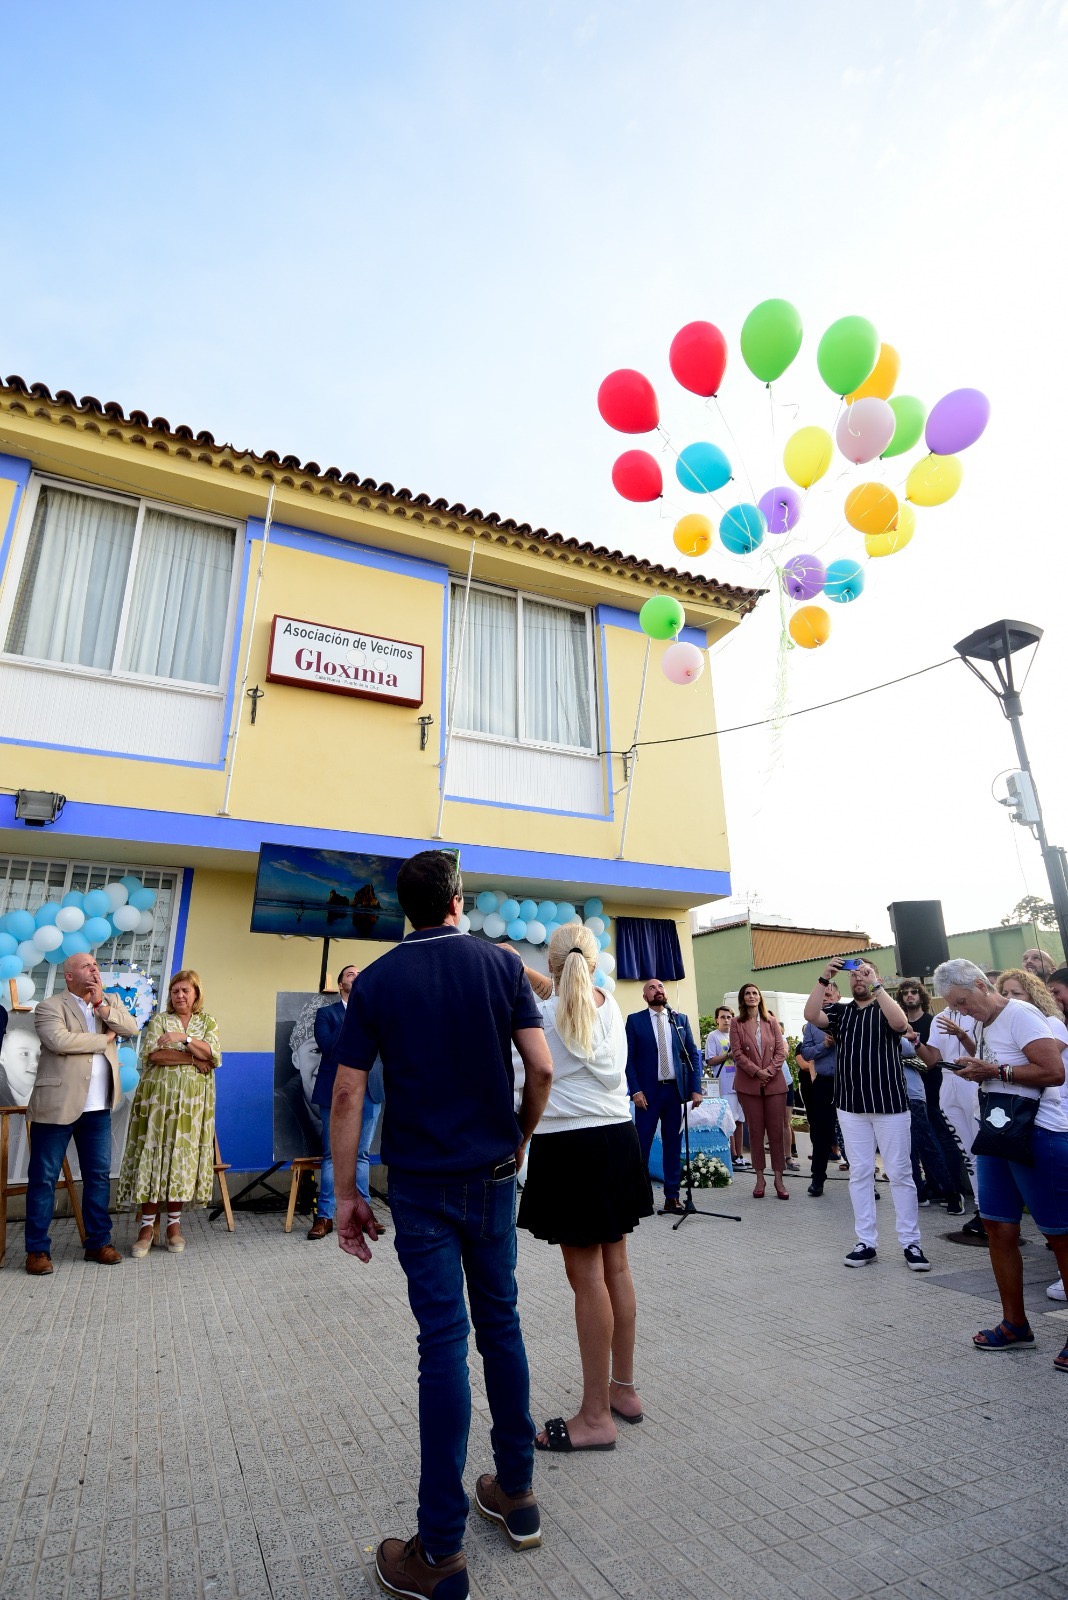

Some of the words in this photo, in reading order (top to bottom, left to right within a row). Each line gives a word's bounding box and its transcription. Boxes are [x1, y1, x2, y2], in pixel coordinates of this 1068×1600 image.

[283, 623, 349, 646] Asociación
[353, 638, 367, 650] de
[371, 640, 413, 659] Vecinos
[295, 648, 398, 687] Gloxinia
